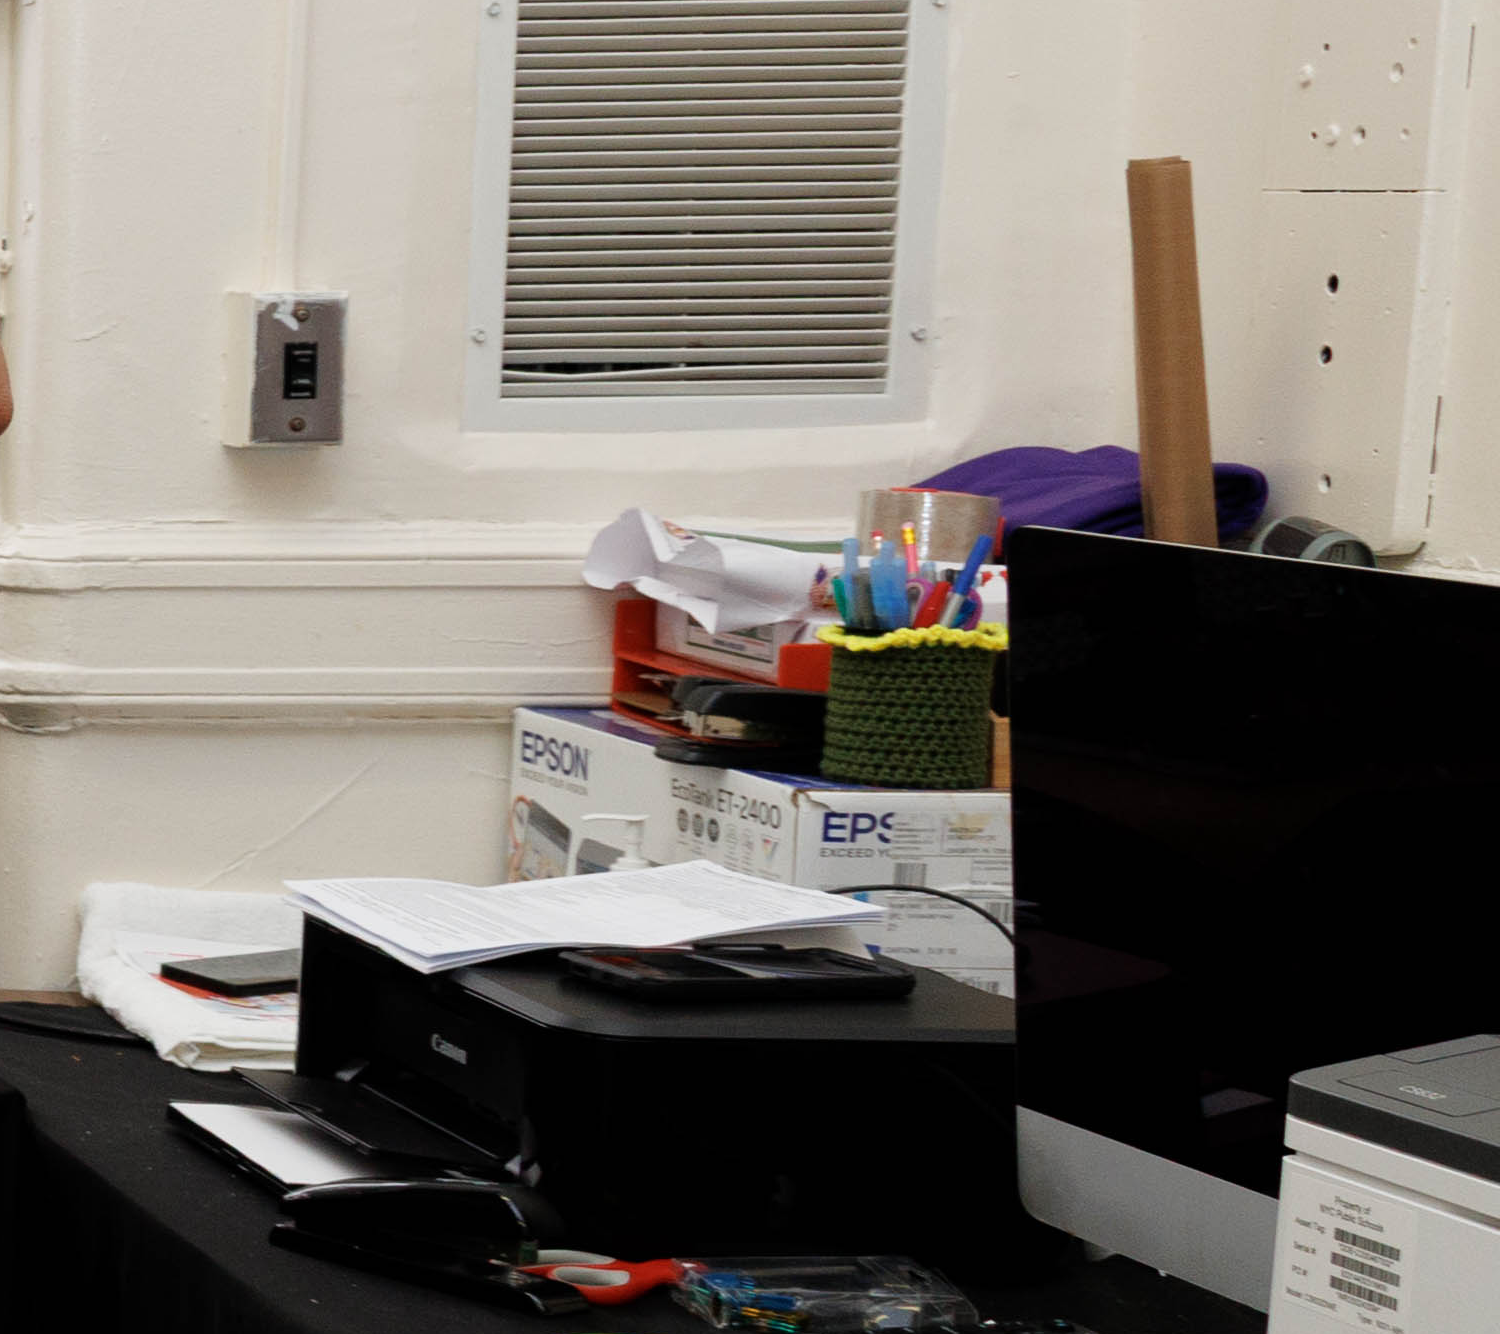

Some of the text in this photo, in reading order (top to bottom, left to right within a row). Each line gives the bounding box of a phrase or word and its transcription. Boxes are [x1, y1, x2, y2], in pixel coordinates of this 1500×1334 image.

[521, 730, 589, 780] EPSON
[716, 788, 782, 830] ET-2400
[819, 847, 875, 858] EXCEED
[431, 1033, 467, 1065] Canon
